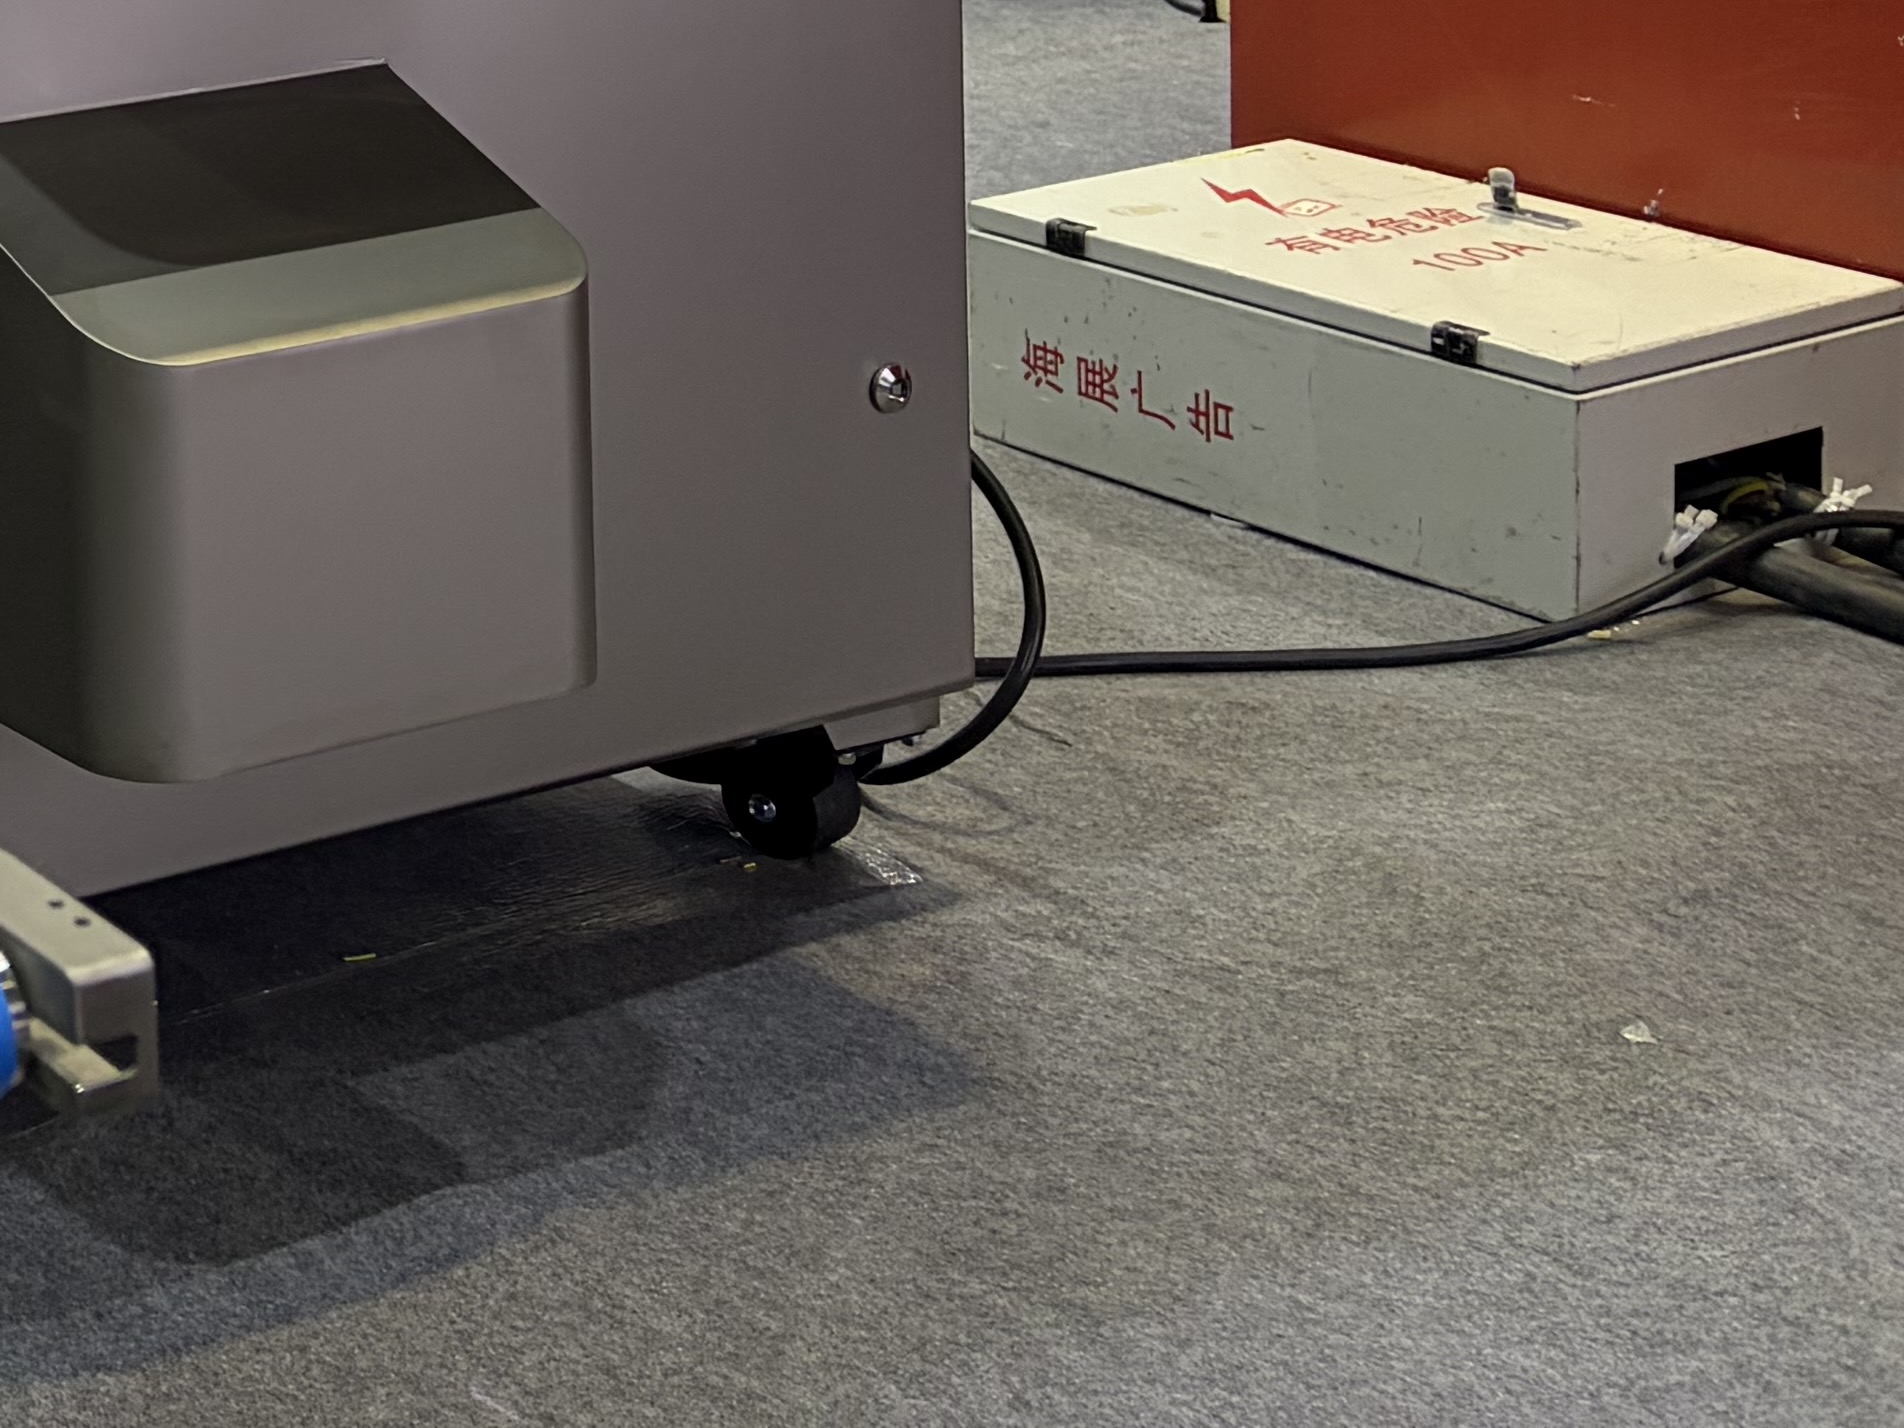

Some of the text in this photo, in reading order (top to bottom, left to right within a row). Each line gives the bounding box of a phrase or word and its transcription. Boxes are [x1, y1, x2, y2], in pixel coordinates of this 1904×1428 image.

[1265, 203, 1485, 259] 有电危险
[1411, 240, 1548, 273] 100A
[1020, 330, 1236, 443] 海展广告
